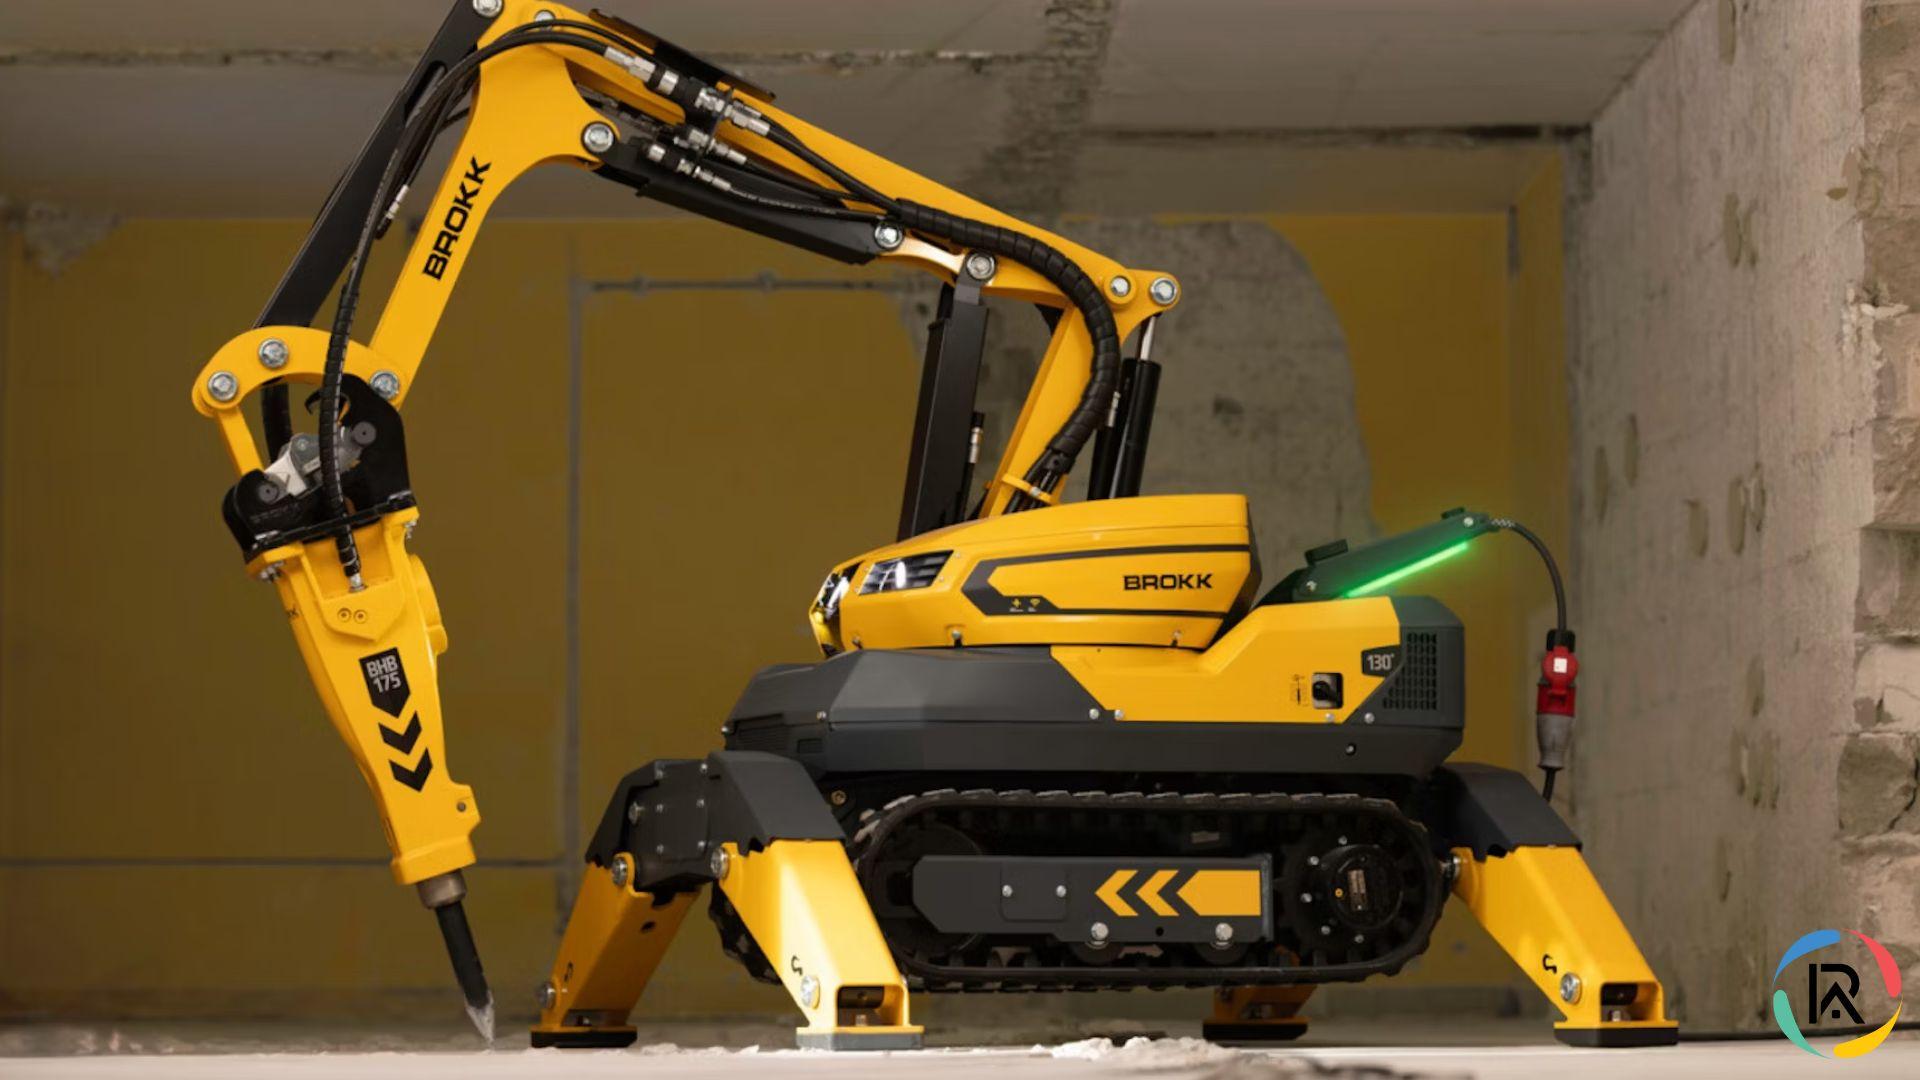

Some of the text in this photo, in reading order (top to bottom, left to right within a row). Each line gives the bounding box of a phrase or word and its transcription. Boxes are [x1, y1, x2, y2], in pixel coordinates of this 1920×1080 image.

[423, 156, 492, 280] BROKK
[1124, 573, 1213, 590] BROKK
[366, 655, 398, 678] BHB
[373, 671, 401, 693] 175
